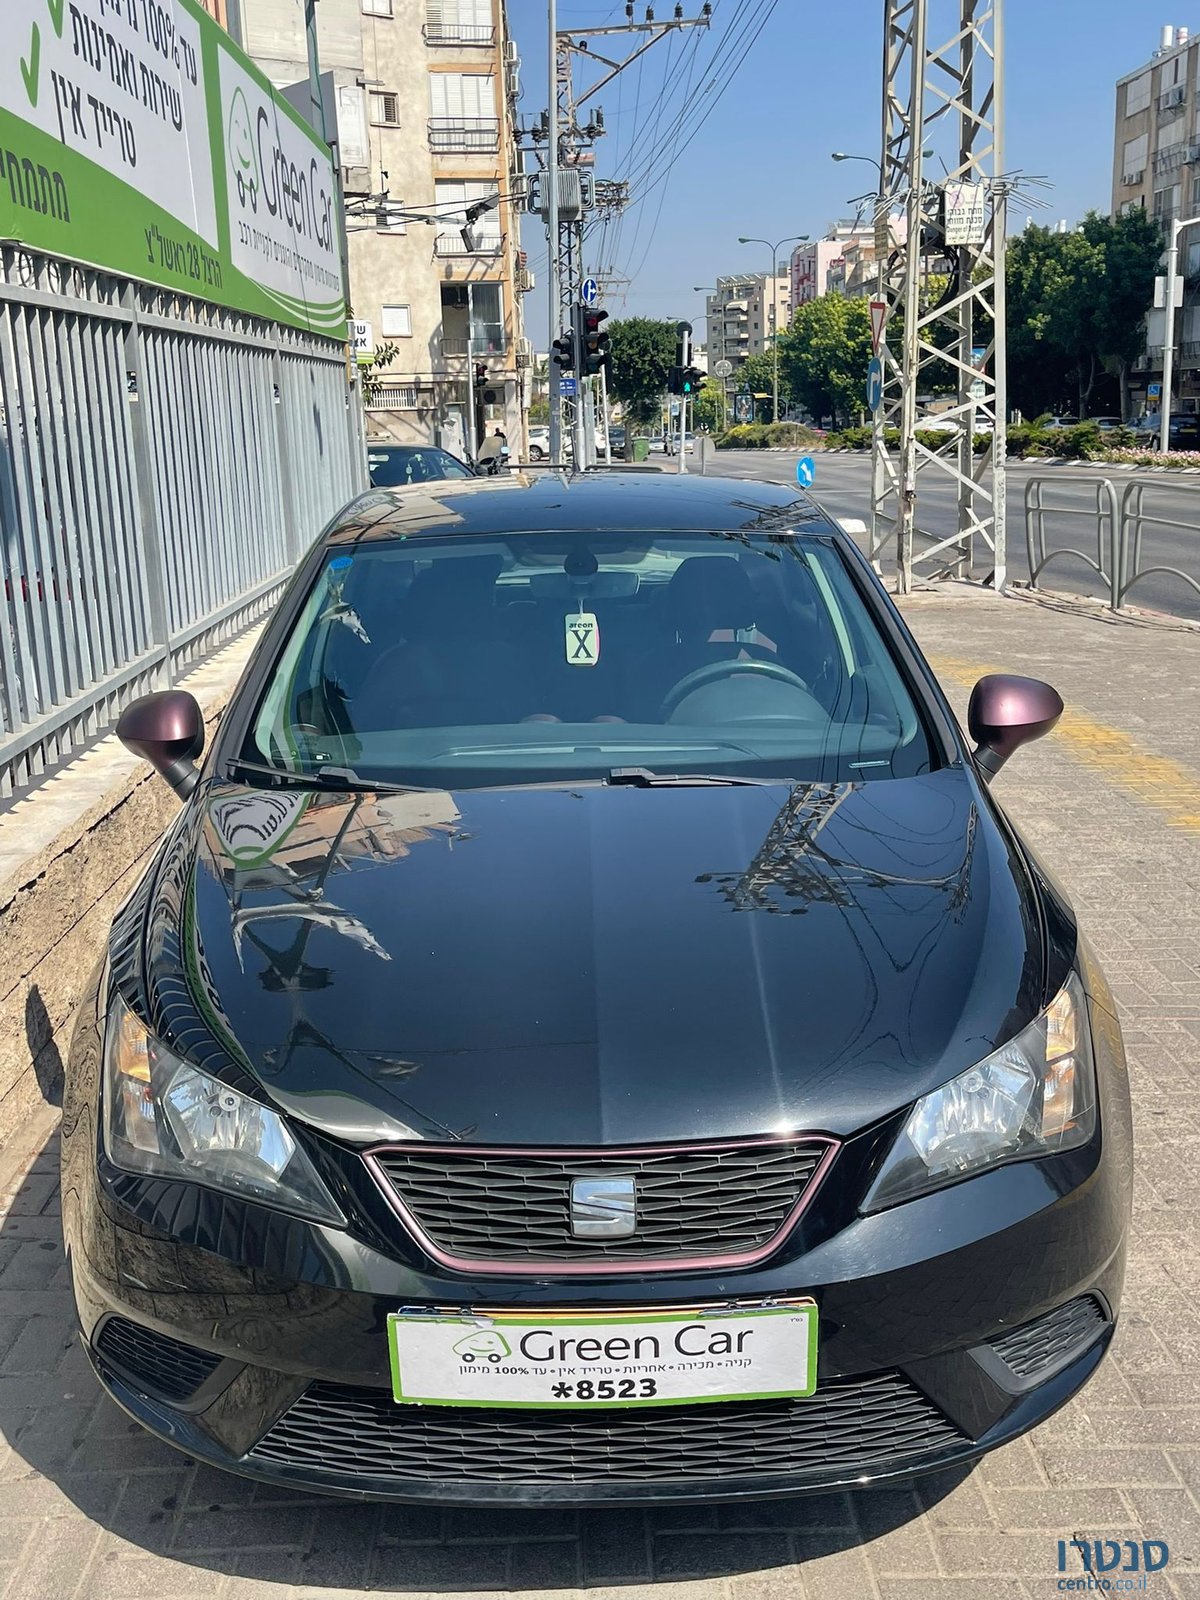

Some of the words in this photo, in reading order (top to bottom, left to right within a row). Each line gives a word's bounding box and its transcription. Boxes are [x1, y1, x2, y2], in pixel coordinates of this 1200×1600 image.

[69, 2, 139, 100] ואמינות
[180, 35, 197, 86] עד
[51, 69, 87, 145] אין
[139, 60, 183, 132] שירות
[87, 93, 136, 168] טרייד
[257, 106, 312, 239] Green
[310, 157, 333, 254] Car
[145, 224, 187, 275] ראשל"צ
[238, 220, 252, 248] רכב
[187, 241, 200, 280] 28
[200, 245, 222, 289] הרצל
[570, 629, 594, 659] X
[520, 1329, 660, 1361] Green
[674, 1324, 754, 1357] Car
[459, 1365, 490, 1376] מימון
[494, 1366, 530, 1375] 100%
[533, 1366, 547, 1375] עד
[559, 1366, 576, 1377] אין
[580, 1366, 612, 1375] טרייד
[623, 1363, 666, 1374] אחריות
[677, 1360, 714, 1371] מכירה
[725, 1358, 752, 1370] קניה
